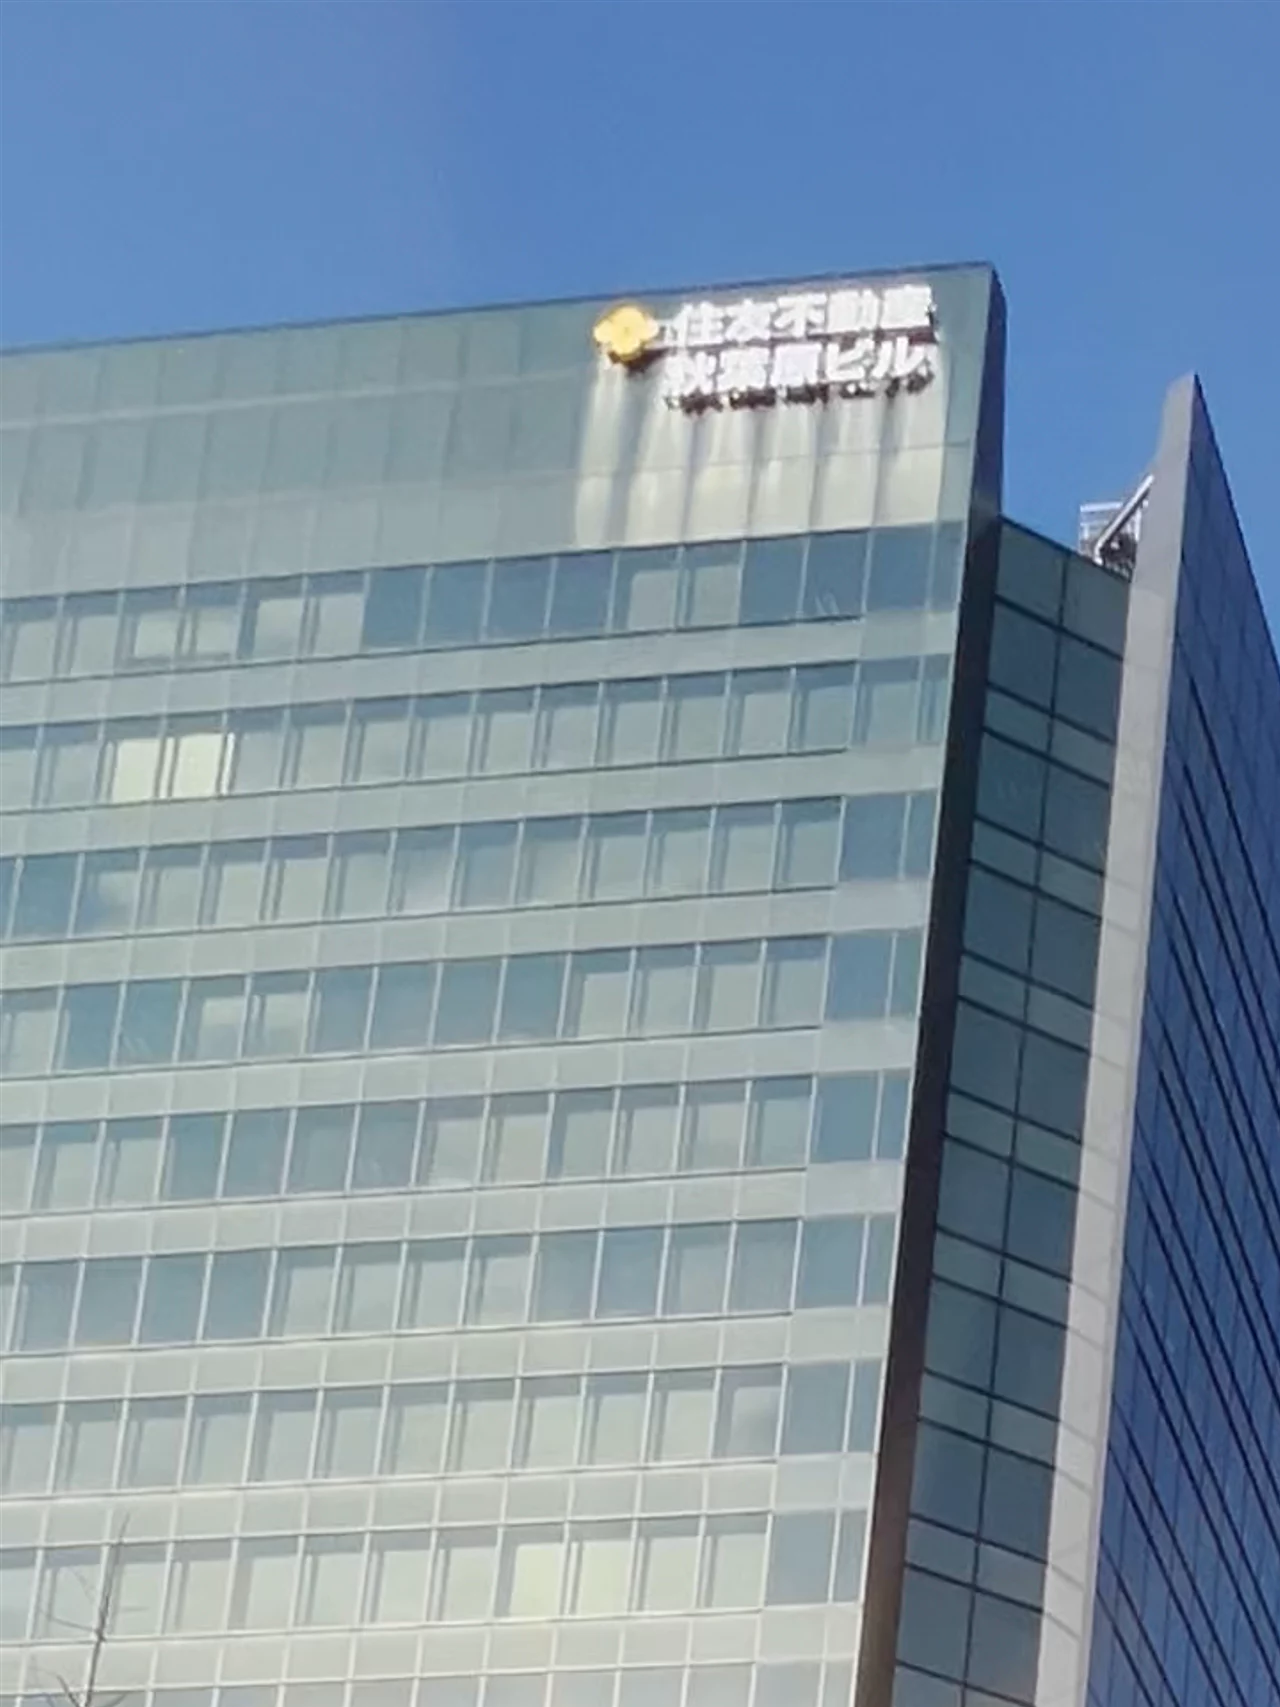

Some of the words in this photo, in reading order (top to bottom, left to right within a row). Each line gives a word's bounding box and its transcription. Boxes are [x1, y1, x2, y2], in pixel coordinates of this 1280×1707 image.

[665, 284, 937, 346] 住友不動産
[660, 336, 939, 398] 秋葉原ビル
